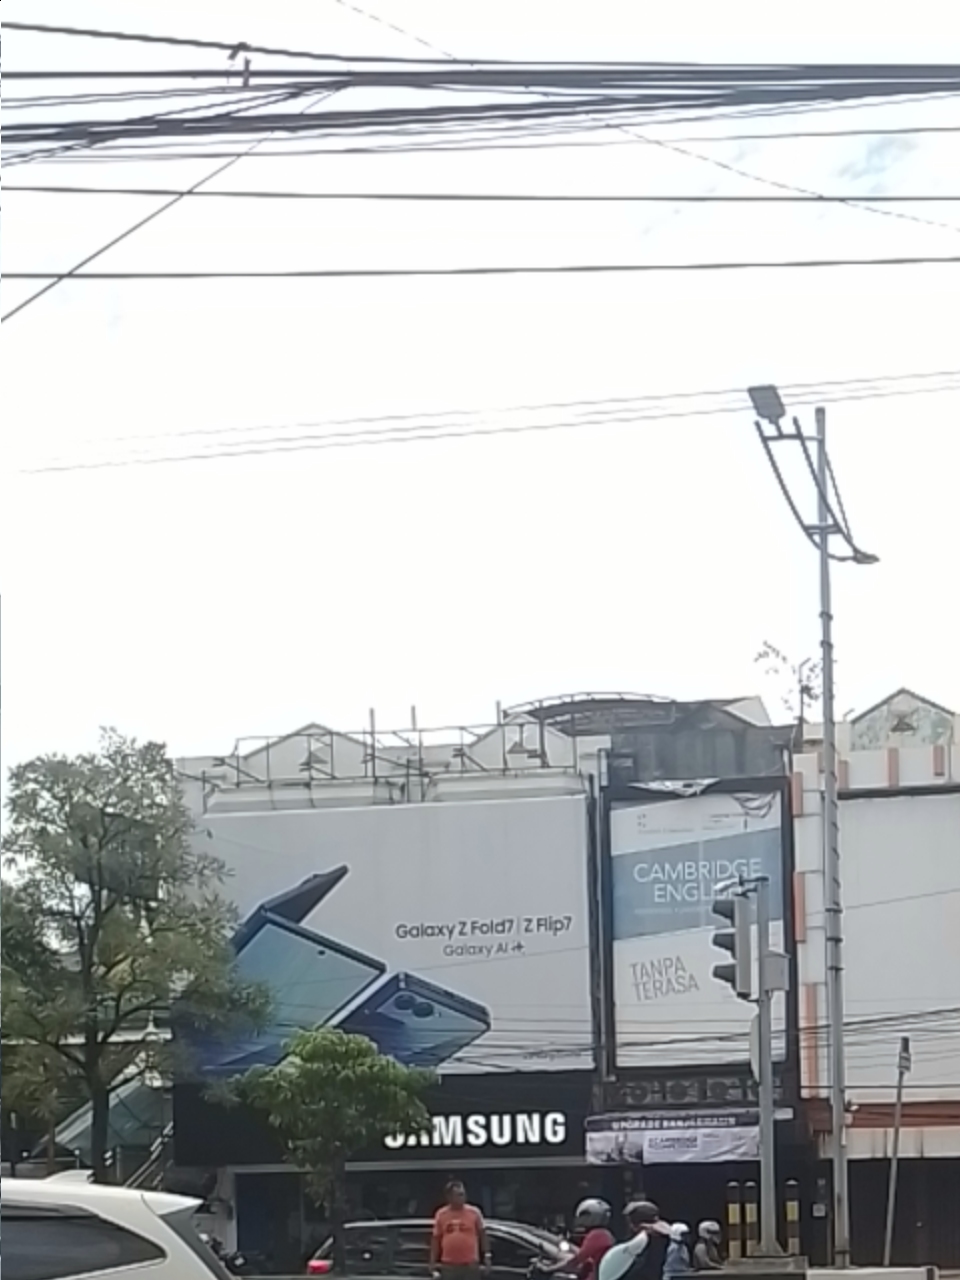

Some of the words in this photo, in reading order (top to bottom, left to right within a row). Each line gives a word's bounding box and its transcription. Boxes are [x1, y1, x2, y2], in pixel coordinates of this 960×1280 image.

[633, 858, 762, 883] CAMBRIDGE
[395, 923, 456, 940] Galaxy
[458, 921, 468, 936] Z
[470, 919, 514, 935] Fold7
[523, 918, 534, 933] Z
[536, 915, 573, 936] Flip7
[443, 945, 493, 959] Galaxy
[630, 956, 687, 983] TANPA
[634, 973, 699, 1001] TERASA
